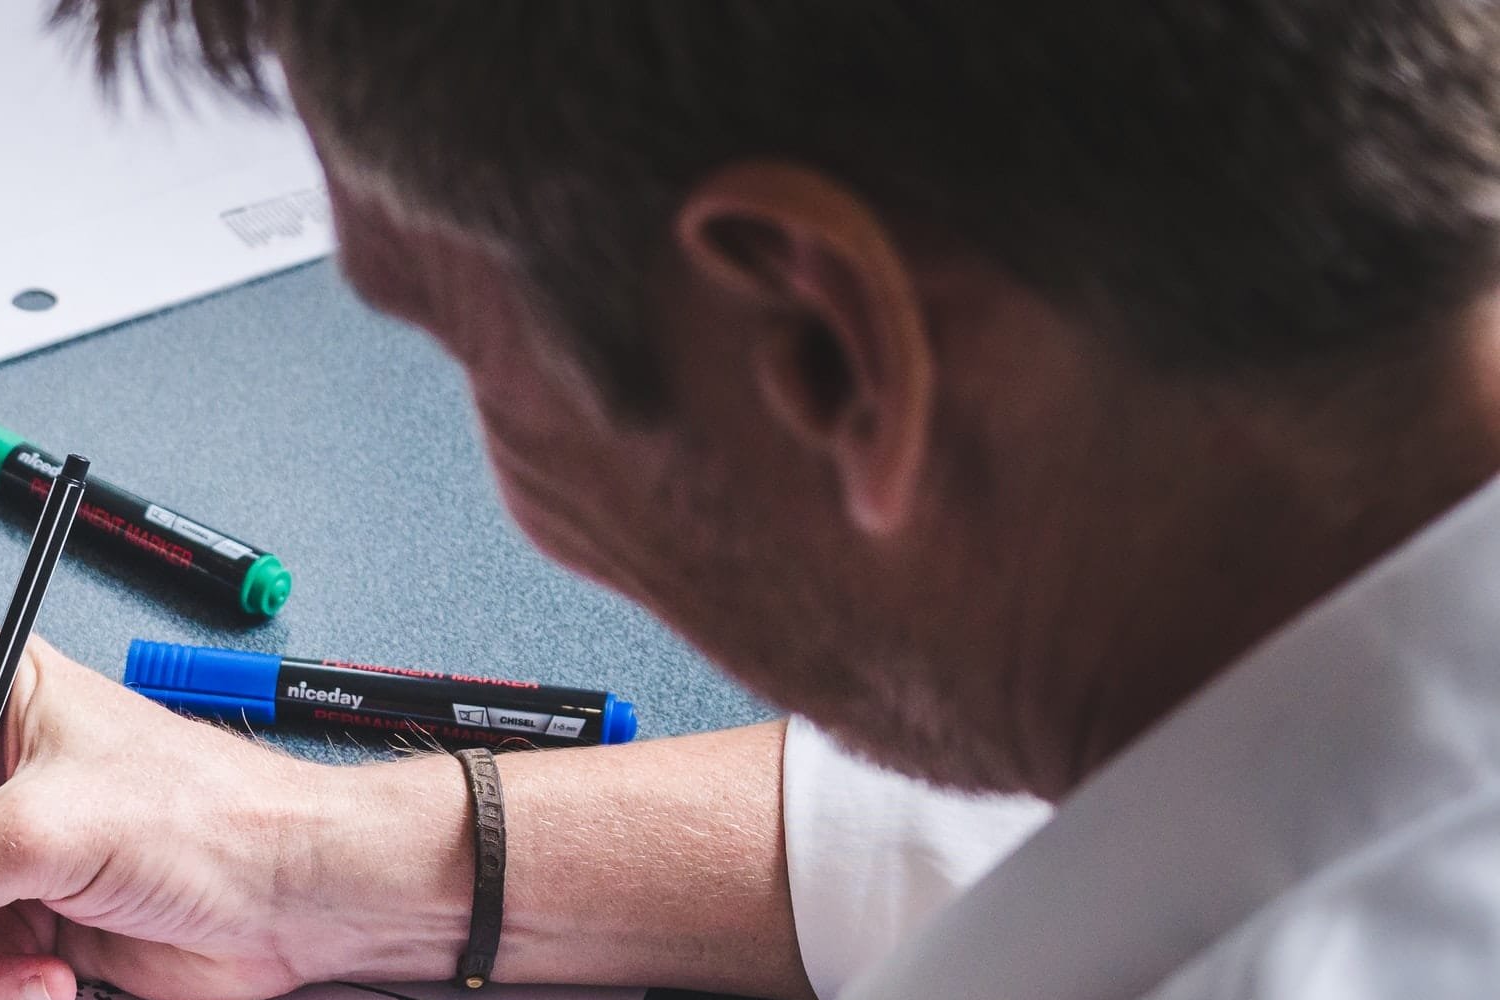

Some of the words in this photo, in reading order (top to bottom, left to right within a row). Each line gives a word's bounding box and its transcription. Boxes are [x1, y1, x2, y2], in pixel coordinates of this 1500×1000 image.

[17, 452, 63, 478] niced
[124, 523, 193, 568] MARKER
[287, 681, 363, 709] niceday
[499, 716, 537, 728] CHISEL
